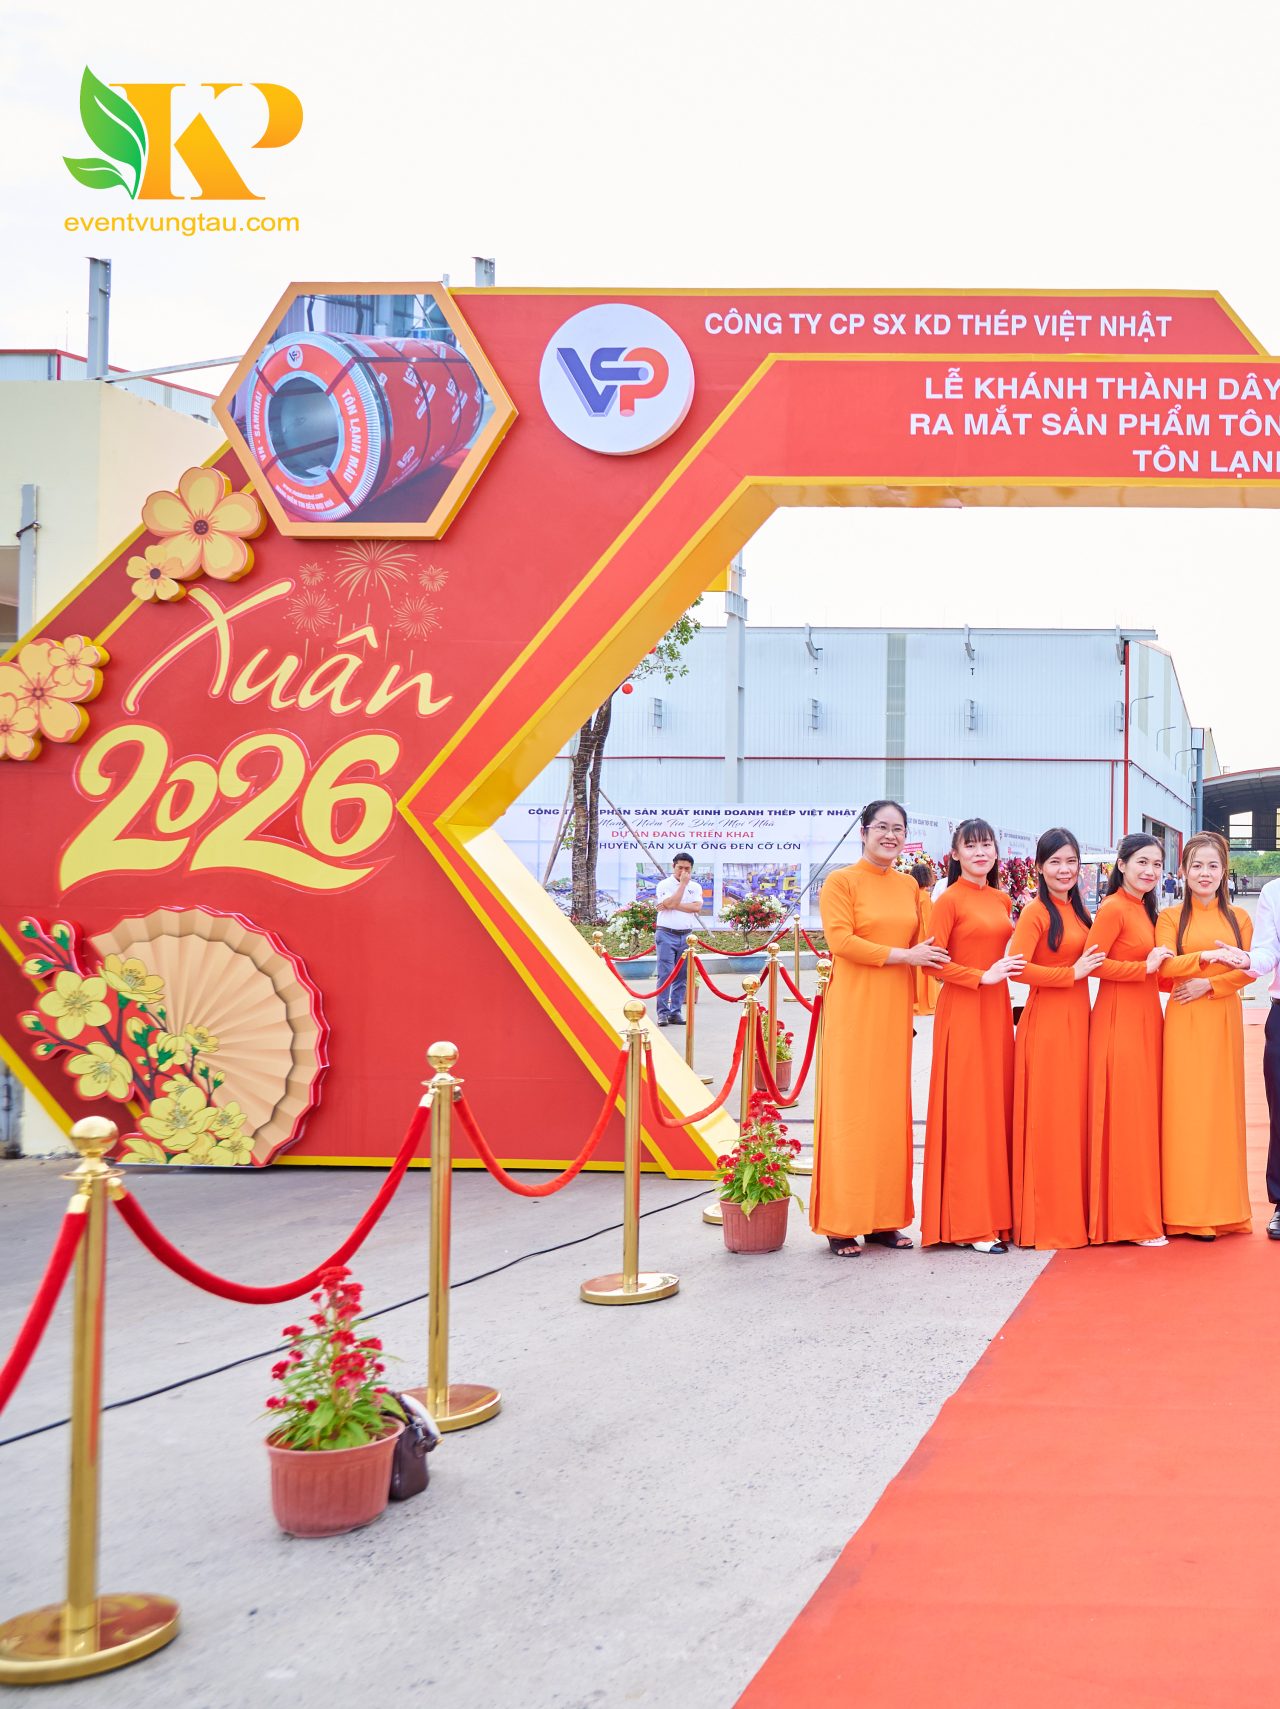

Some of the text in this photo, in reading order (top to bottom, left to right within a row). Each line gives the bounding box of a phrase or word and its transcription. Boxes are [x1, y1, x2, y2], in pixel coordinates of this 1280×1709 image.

[705, 308, 1172, 343] CÔNG TY CP SX KD THÉP VIỆT NHẬT
[925, 367, 963, 399] LỄ
[974, 372, 1087, 400] KHÁNH
[1096, 372, 1207, 400] THÀNH
[253, 391, 263, 437] SAMURAI
[341, 388, 357, 416] TÔN
[910, 413, 953, 436] RA
[964, 405, 1032, 436] MẮT
[1042, 407, 1107, 436] SẢN
[1119, 404, 1210, 436] PHẨM
[349, 417, 362, 456] LẠNH
[343, 455, 359, 484] MÀU
[1132, 444, 1199, 472] TÔN
[125, 581, 452, 716] Xuân
[60, 724, 400, 892] 2026
[767, 808, 796, 816] THÉP
[599, 841, 638, 849] HUYỀN
[730, 842, 754, 850] ĐEN
